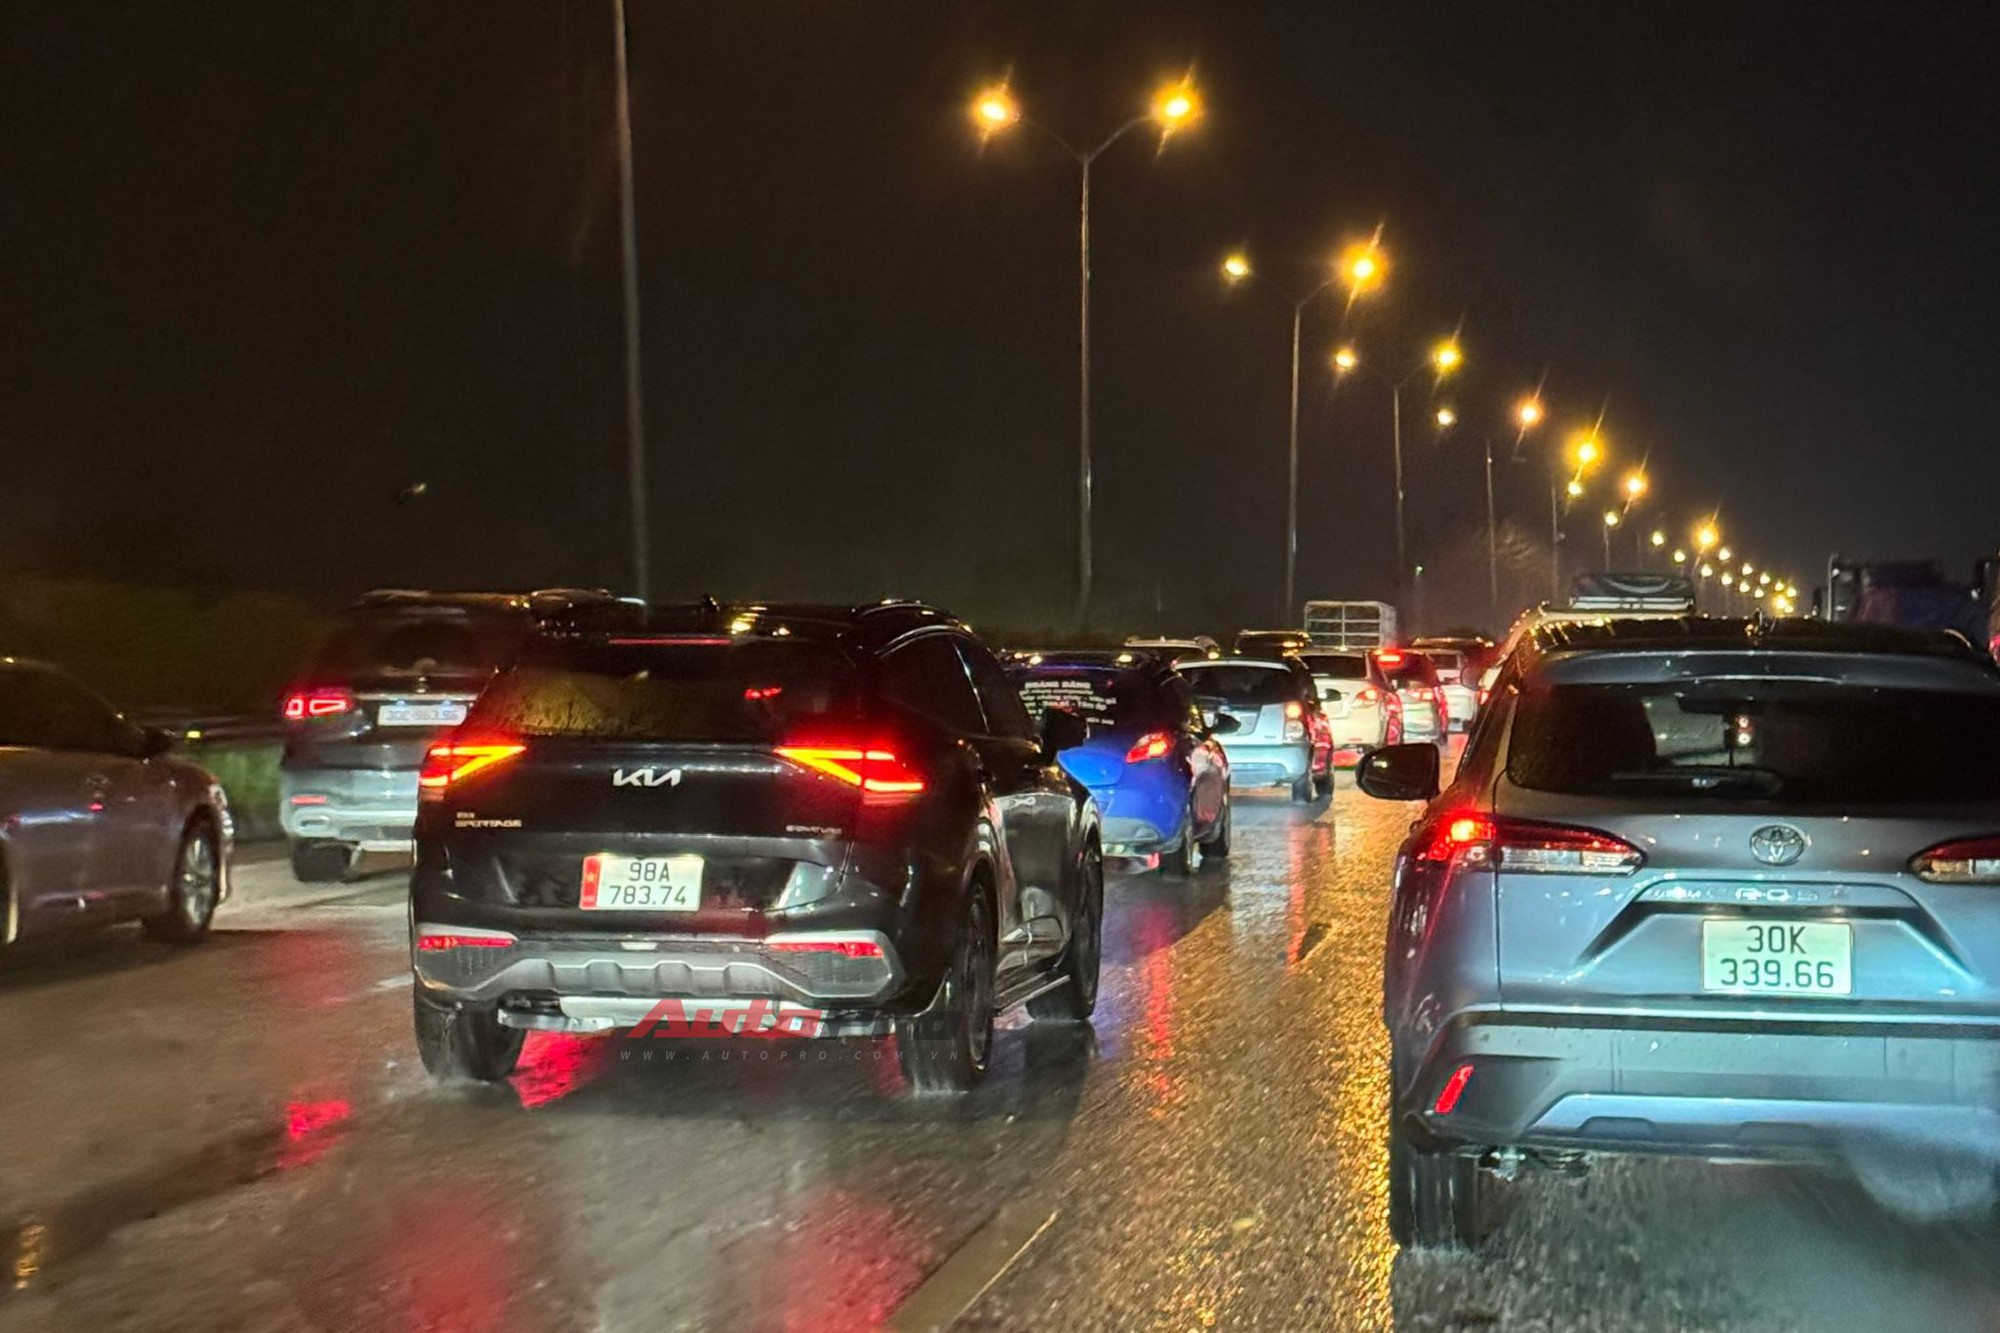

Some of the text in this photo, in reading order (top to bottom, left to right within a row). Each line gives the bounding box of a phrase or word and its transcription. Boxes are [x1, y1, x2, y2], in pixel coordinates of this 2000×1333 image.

[613, 769, 681, 787] KIA
[628, 862, 670, 881] 98A
[609, 885, 686, 905] 783.74
[1746, 926, 1807, 954] 30K
[1720, 958, 1834, 988] 339.66
